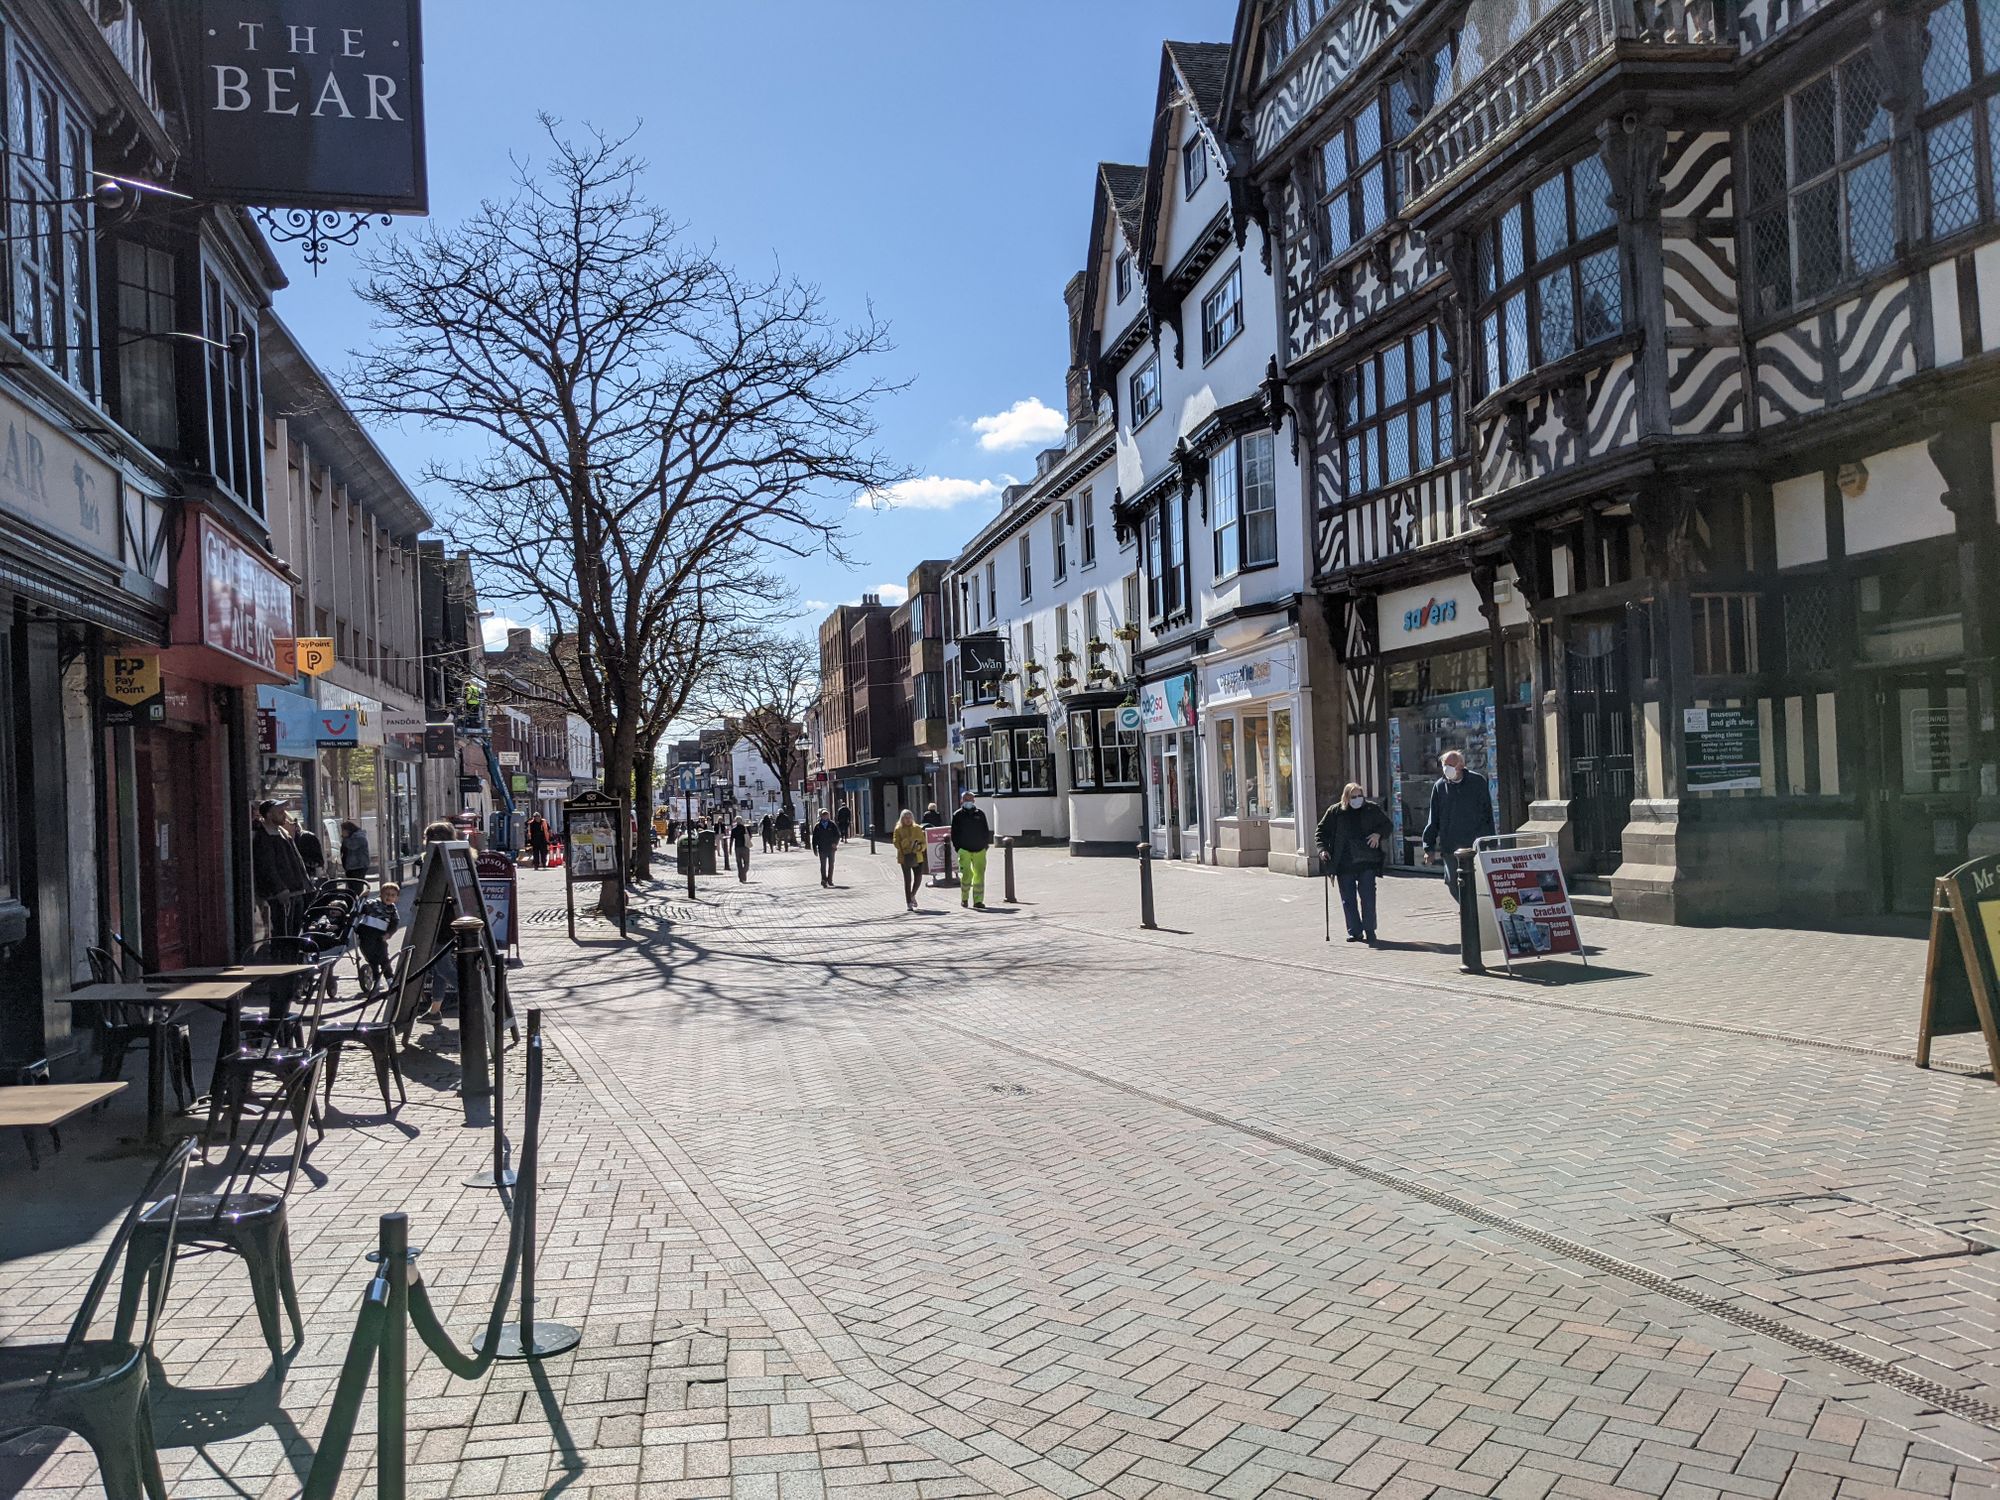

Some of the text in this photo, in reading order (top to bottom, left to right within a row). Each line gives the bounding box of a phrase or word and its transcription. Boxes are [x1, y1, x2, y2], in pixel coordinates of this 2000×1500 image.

[238, 21, 366, 58] THE
[208, 64, 404, 121] BEAR
[205, 531, 292, 626] GREENGATE
[1403, 597, 1457, 632] savers
[232, 606, 276, 661] NEWS
[297, 641, 330, 649] PayPoint
[964, 648, 1002, 673] Swan
[115, 677, 135, 686] Pay
[115, 686, 145, 694] Point
[1725, 718, 1737, 727] gift
[1739, 718, 1755, 726] shop
[1491, 852, 1546, 864] REPAIR WHILE YOU
[1971, 868, 1994, 894] Mr
[1533, 905, 1567, 917] Cracked
[1549, 921, 1569, 929] Screen
[1552, 929, 1571, 937] Repair
